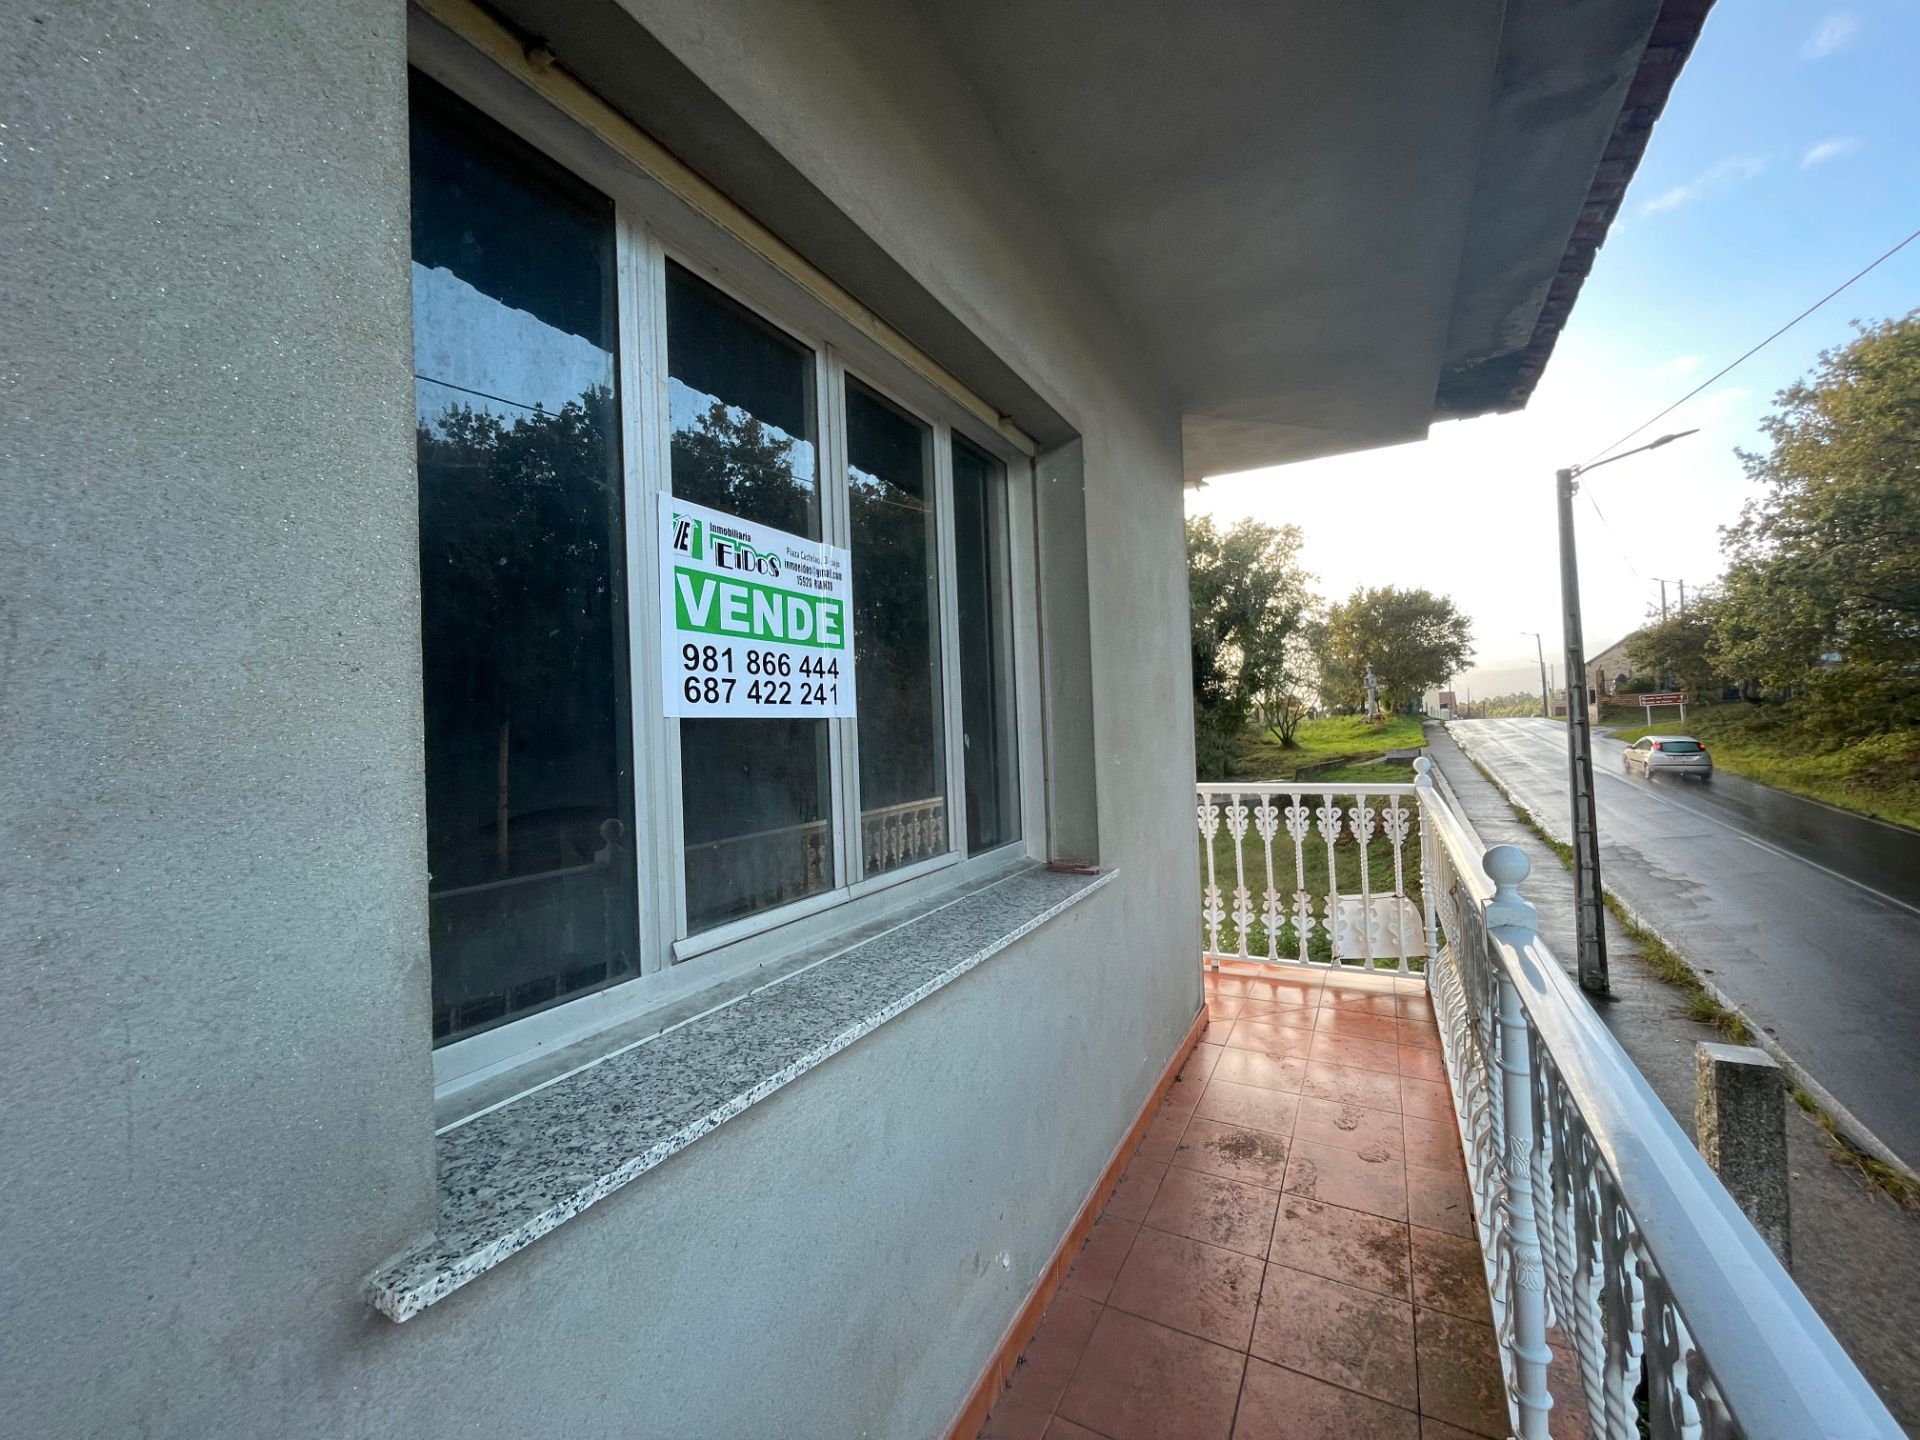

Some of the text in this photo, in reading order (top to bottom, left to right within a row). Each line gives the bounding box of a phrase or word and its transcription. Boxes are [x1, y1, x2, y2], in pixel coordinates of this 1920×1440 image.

[709, 522, 751, 542] Inmobiliaria
[676, 573, 841, 645] VENDE
[683, 643, 840, 679] 981 866 444
[684, 676, 838, 705] 687 422 241
